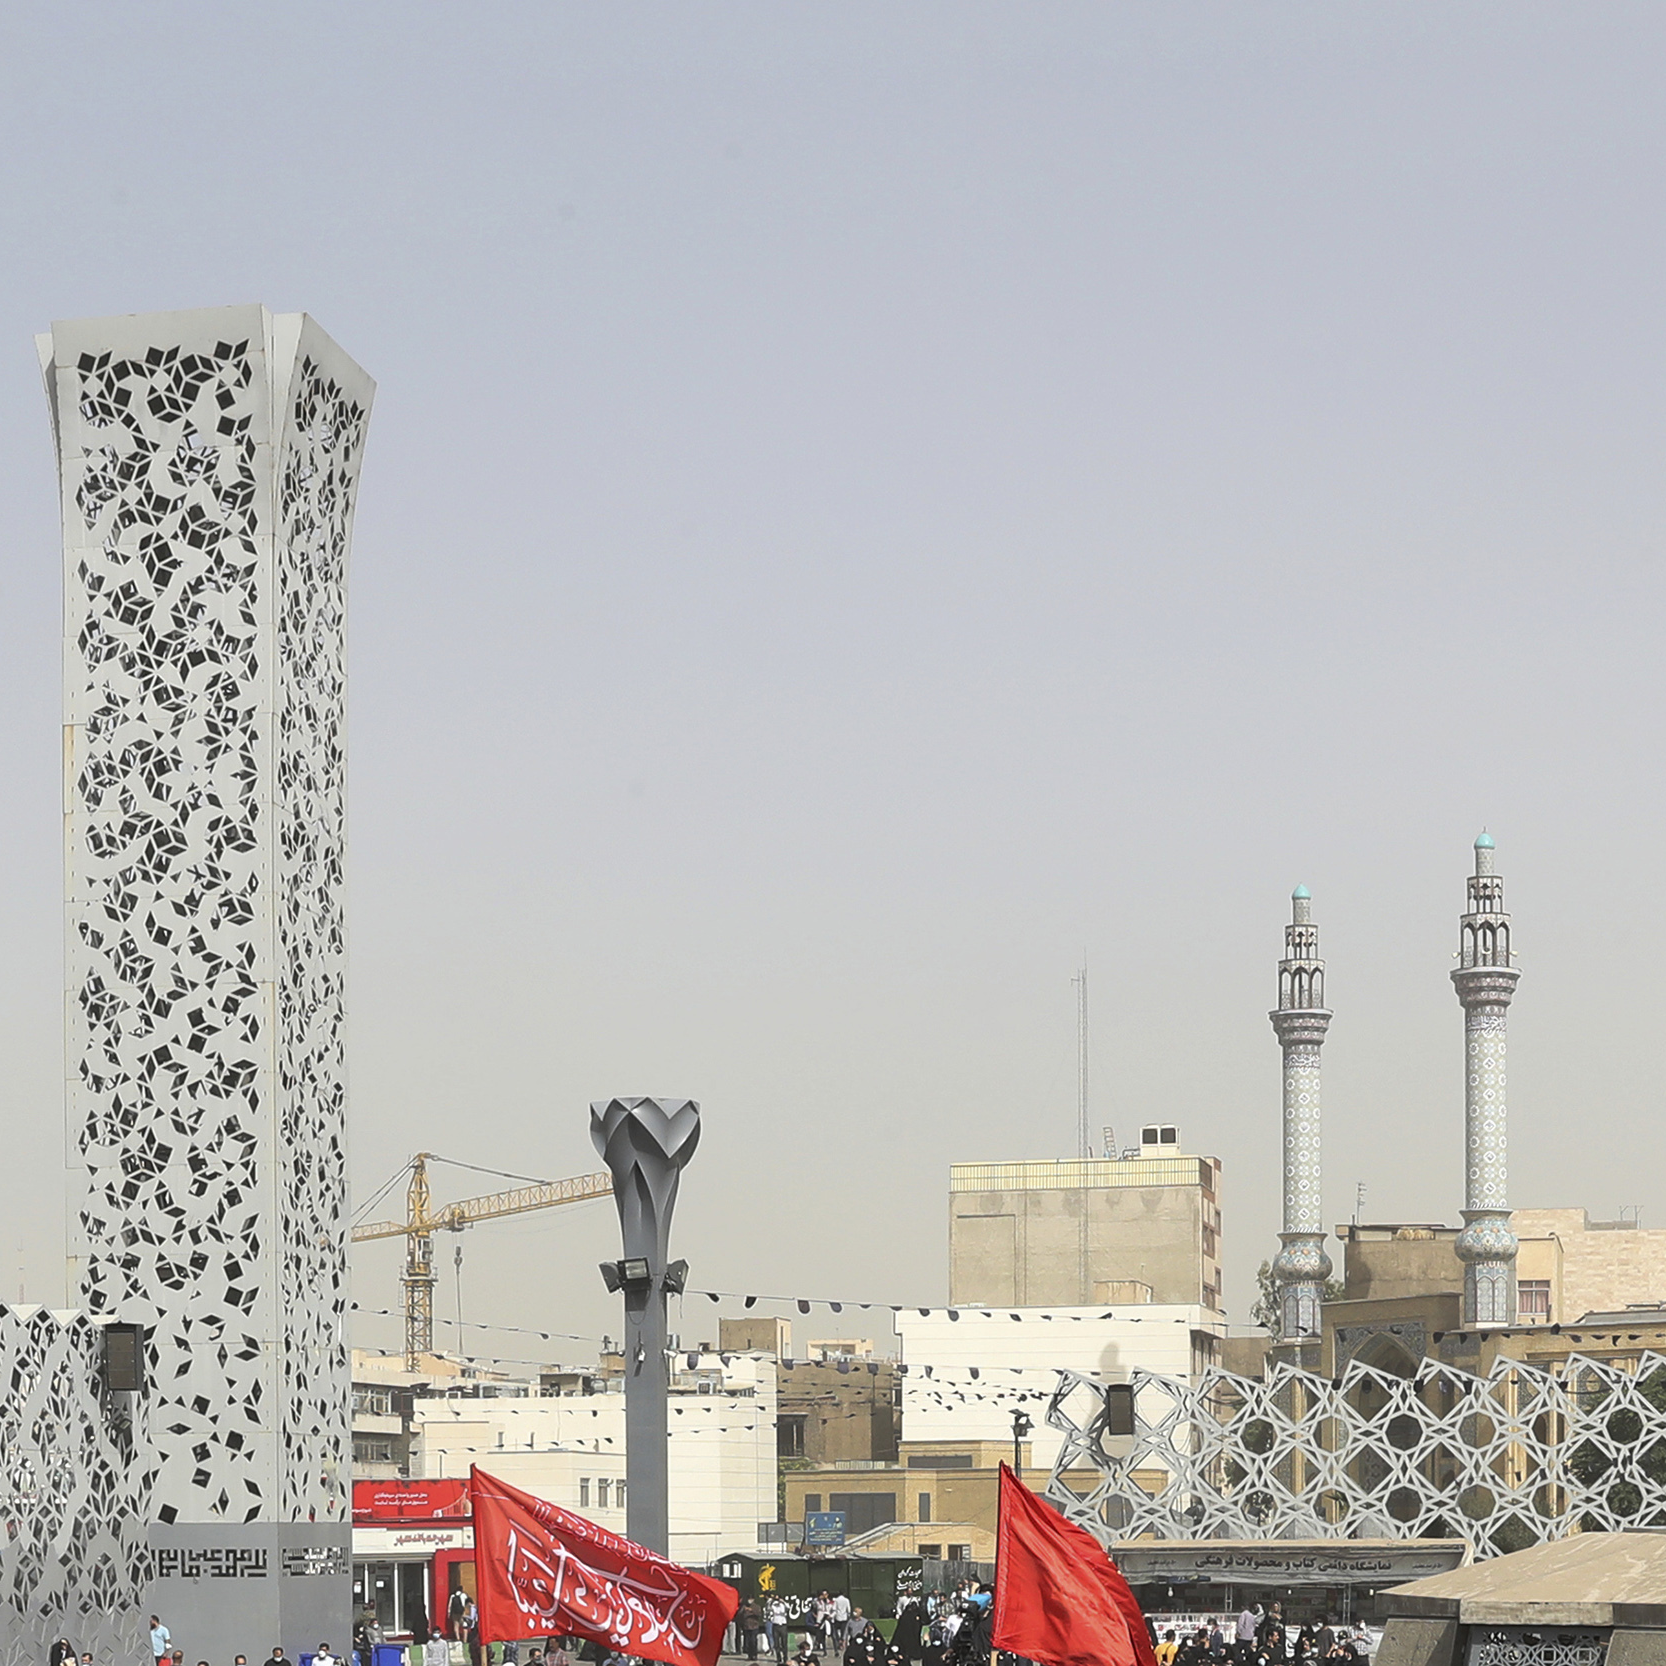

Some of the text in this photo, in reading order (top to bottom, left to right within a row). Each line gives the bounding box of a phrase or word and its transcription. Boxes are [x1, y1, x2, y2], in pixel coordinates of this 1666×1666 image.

[1194, 1554, 1234, 1570] فرهنگی
[1235, 1556, 1284, 1572] محصولات
[1285, 1561, 1292, 1571] و
[1292, 1556, 1317, 1570] کتاب
[1349, 1559, 1392, 1571] نمایشگاه
